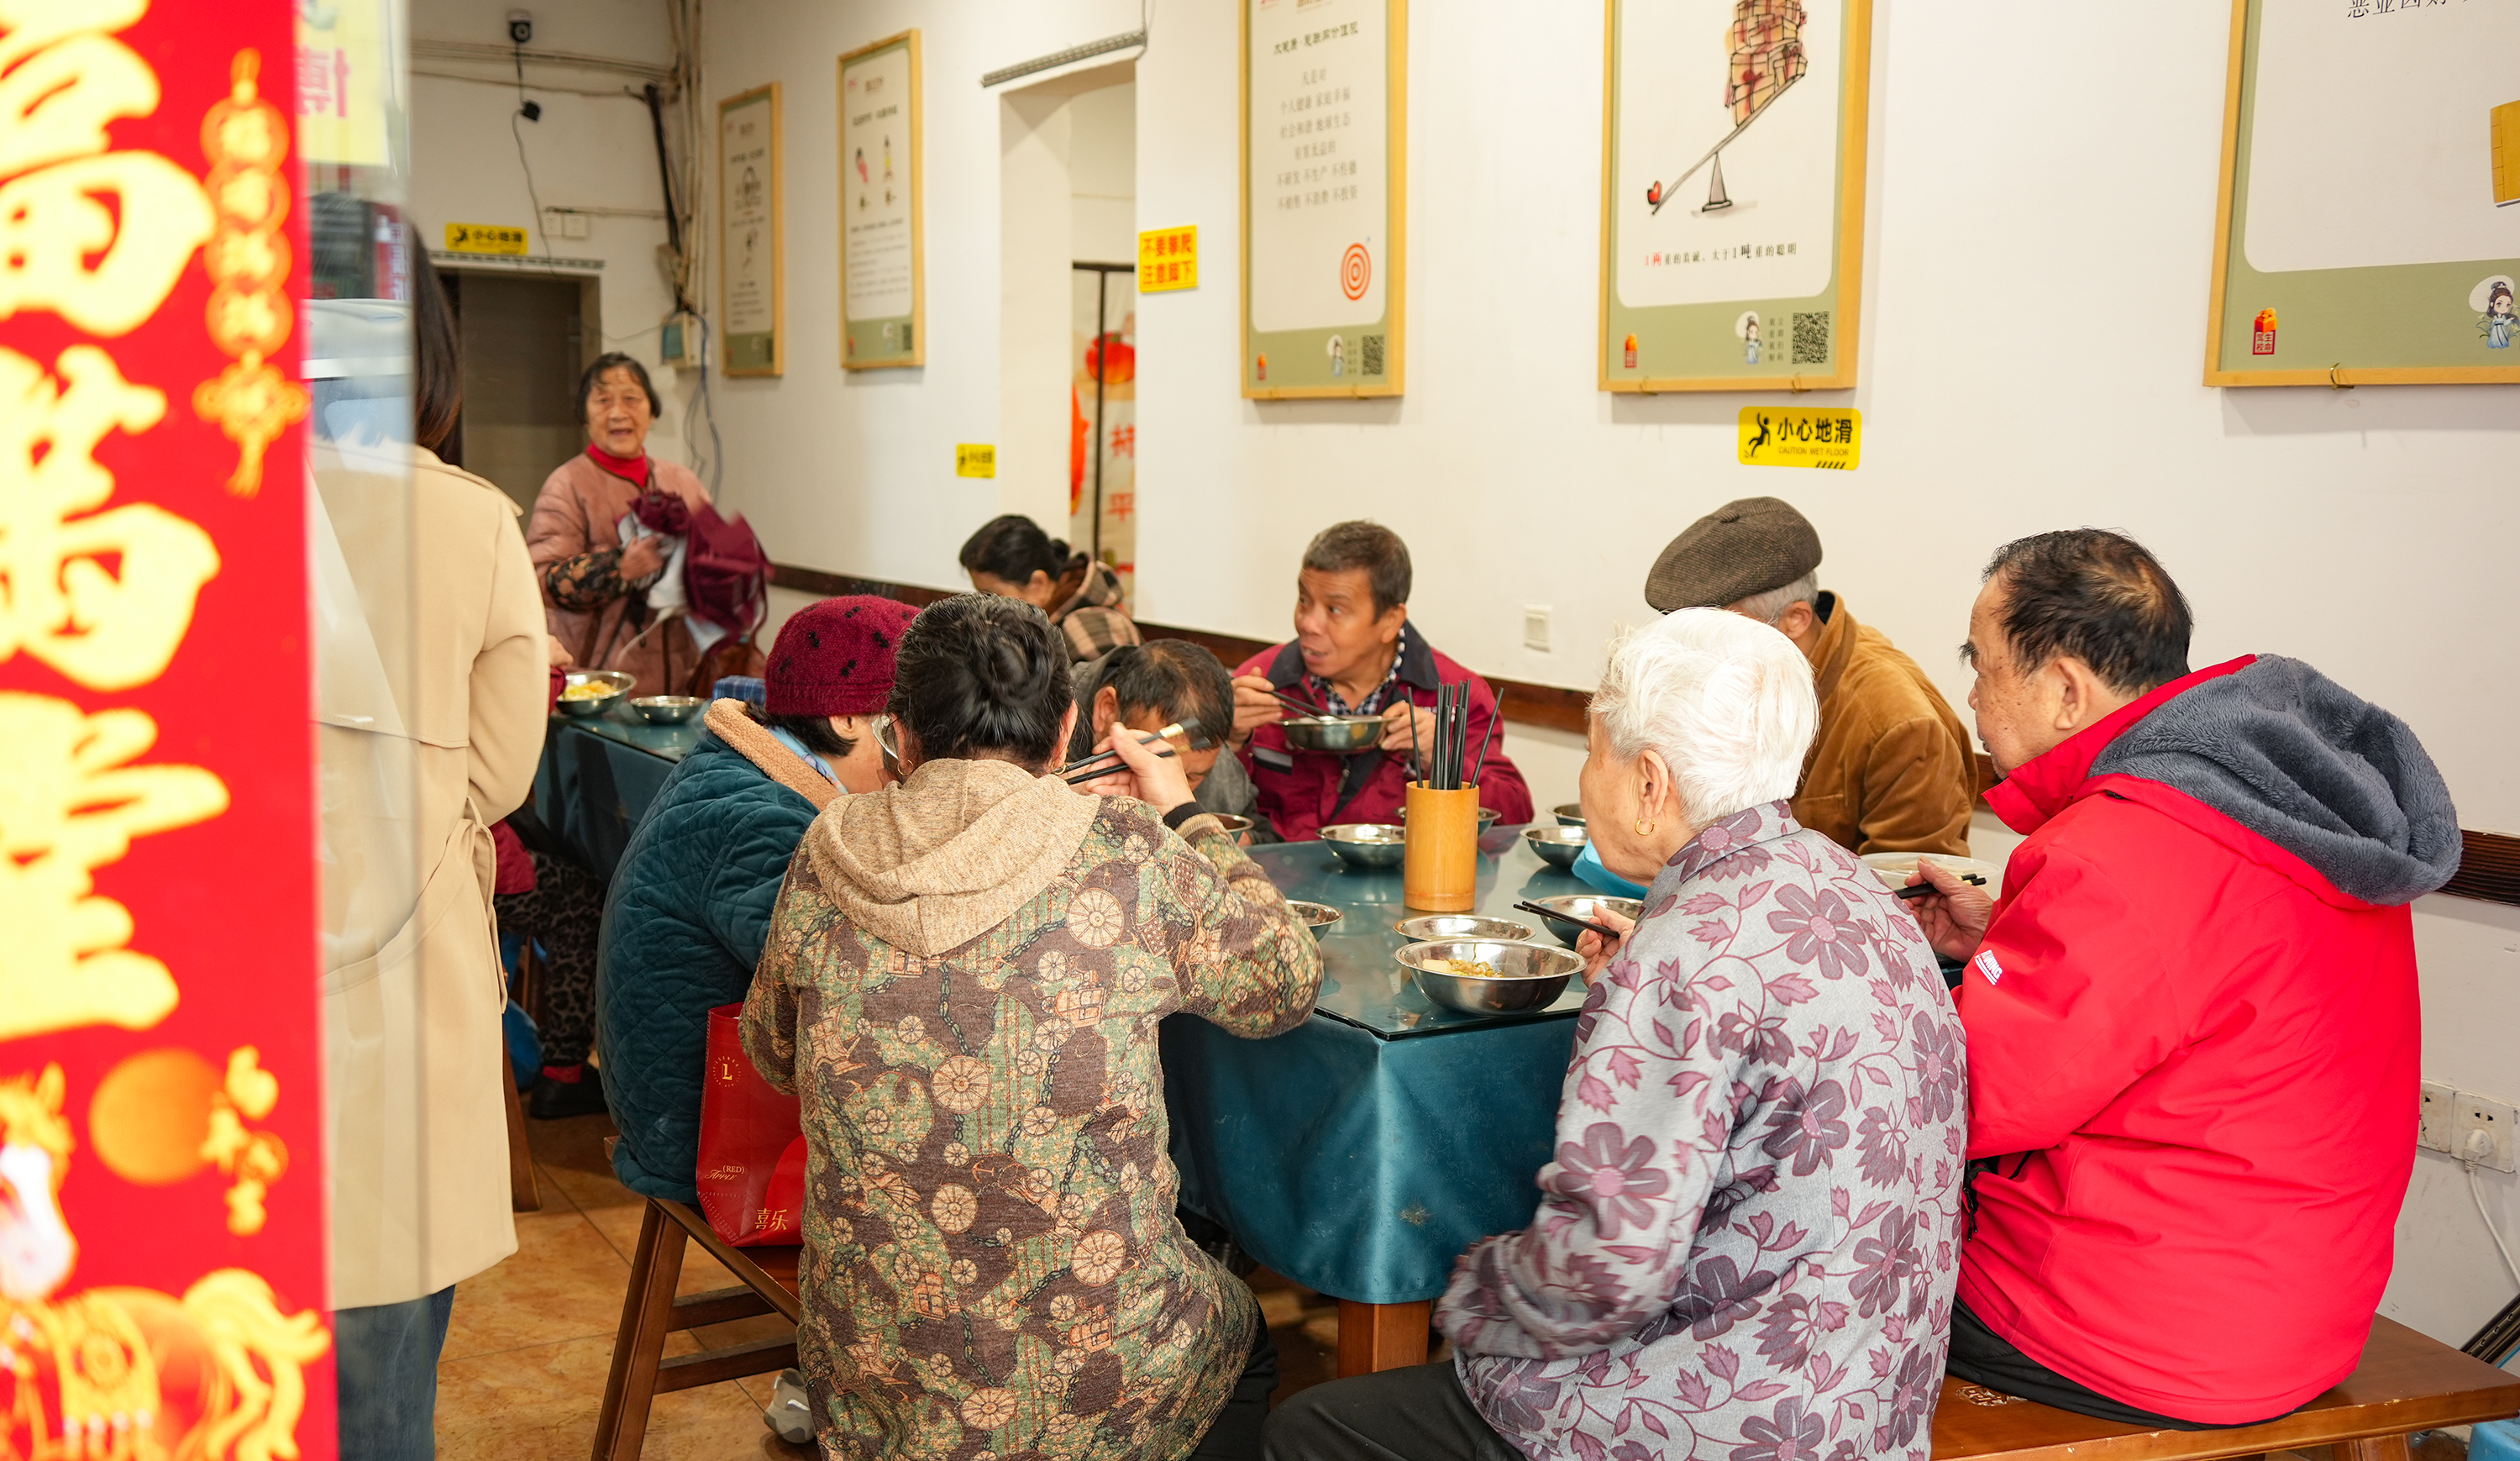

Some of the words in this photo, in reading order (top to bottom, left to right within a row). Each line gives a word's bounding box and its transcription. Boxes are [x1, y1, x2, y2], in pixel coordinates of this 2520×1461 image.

[1143, 260, 1192, 284] 注意脚下
[1777, 417, 1853, 444] 小心地滑
[1778, 446, 1808, 455] CAUTION
[1809, 447, 1824, 455] WET
[1826, 448, 1850, 456] FLOOR
[722, 1063, 732, 1080] L
[722, 1164, 745, 1175] (RED)
[754, 1207, 789, 1232] 喜乐
